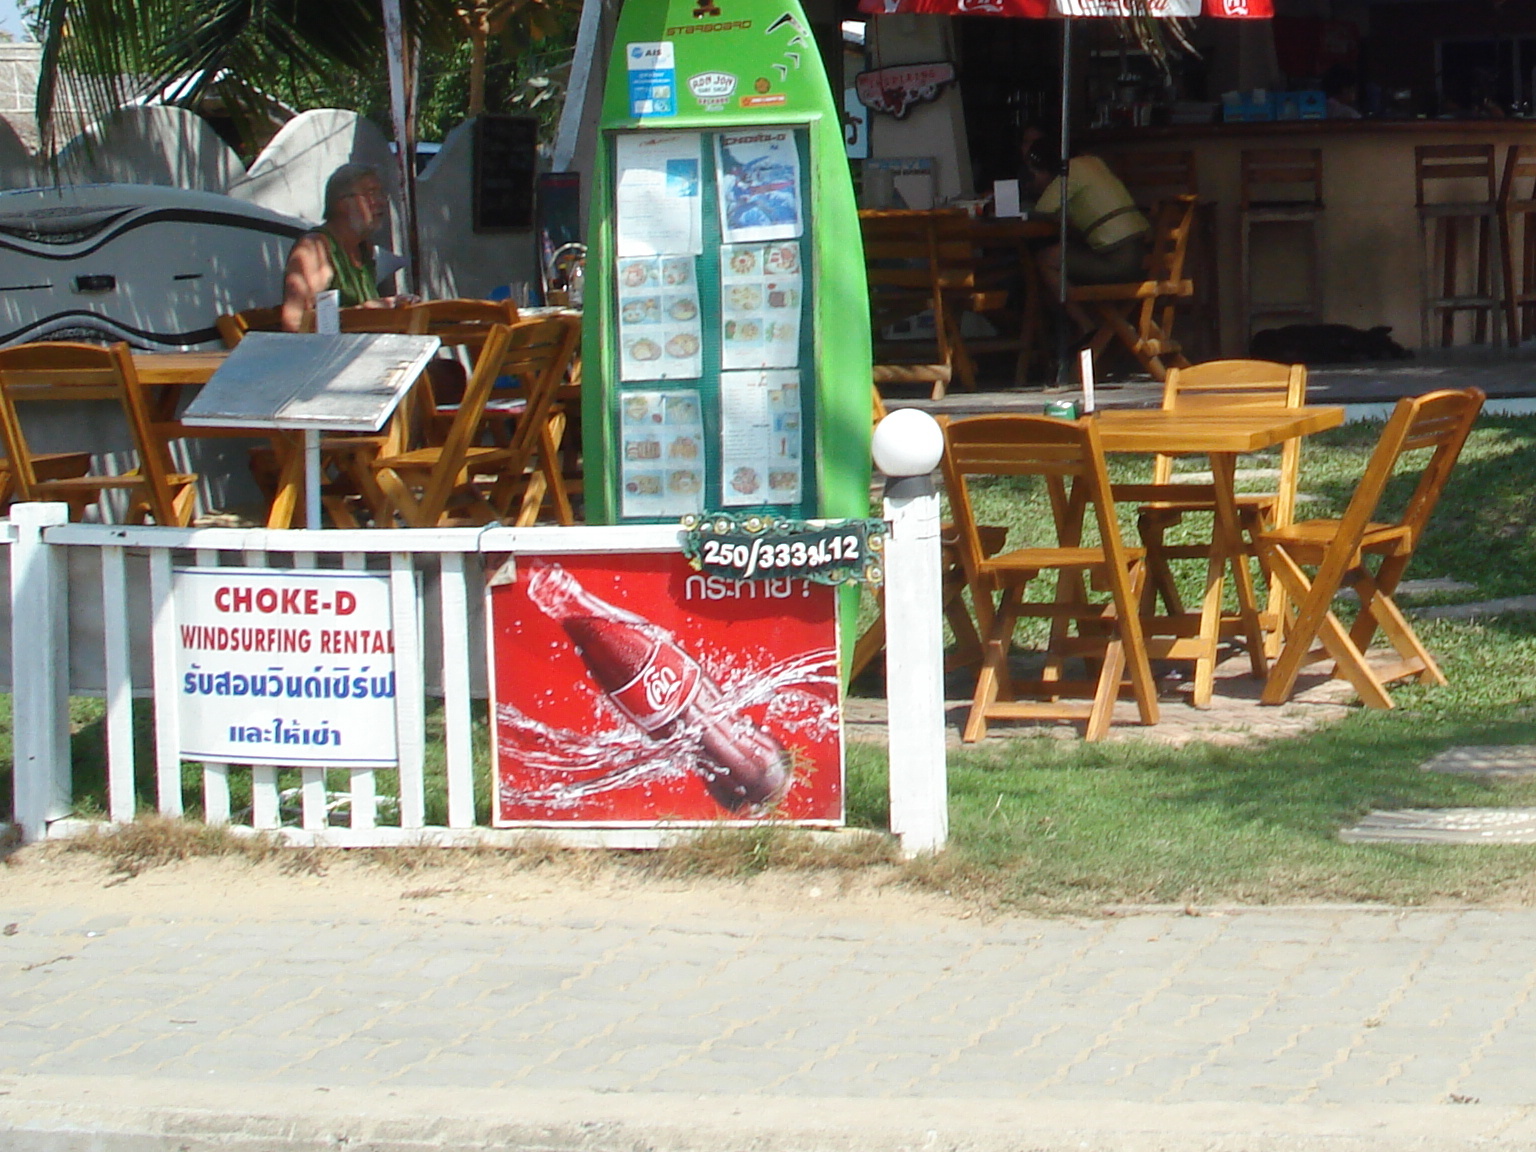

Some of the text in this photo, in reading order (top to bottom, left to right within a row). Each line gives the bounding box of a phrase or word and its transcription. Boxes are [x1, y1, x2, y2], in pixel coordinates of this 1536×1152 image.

[645, 48, 662, 57] AIS
[713, 75, 734, 87] JON
[214, 586, 357, 616] CHOKE-D
[180, 624, 396, 655] WINDSURFING RENTAL
[183, 663, 397, 700] รับสอนวินด์เซิร์ฟ
[228, 718, 342, 747] และให้เช่า
